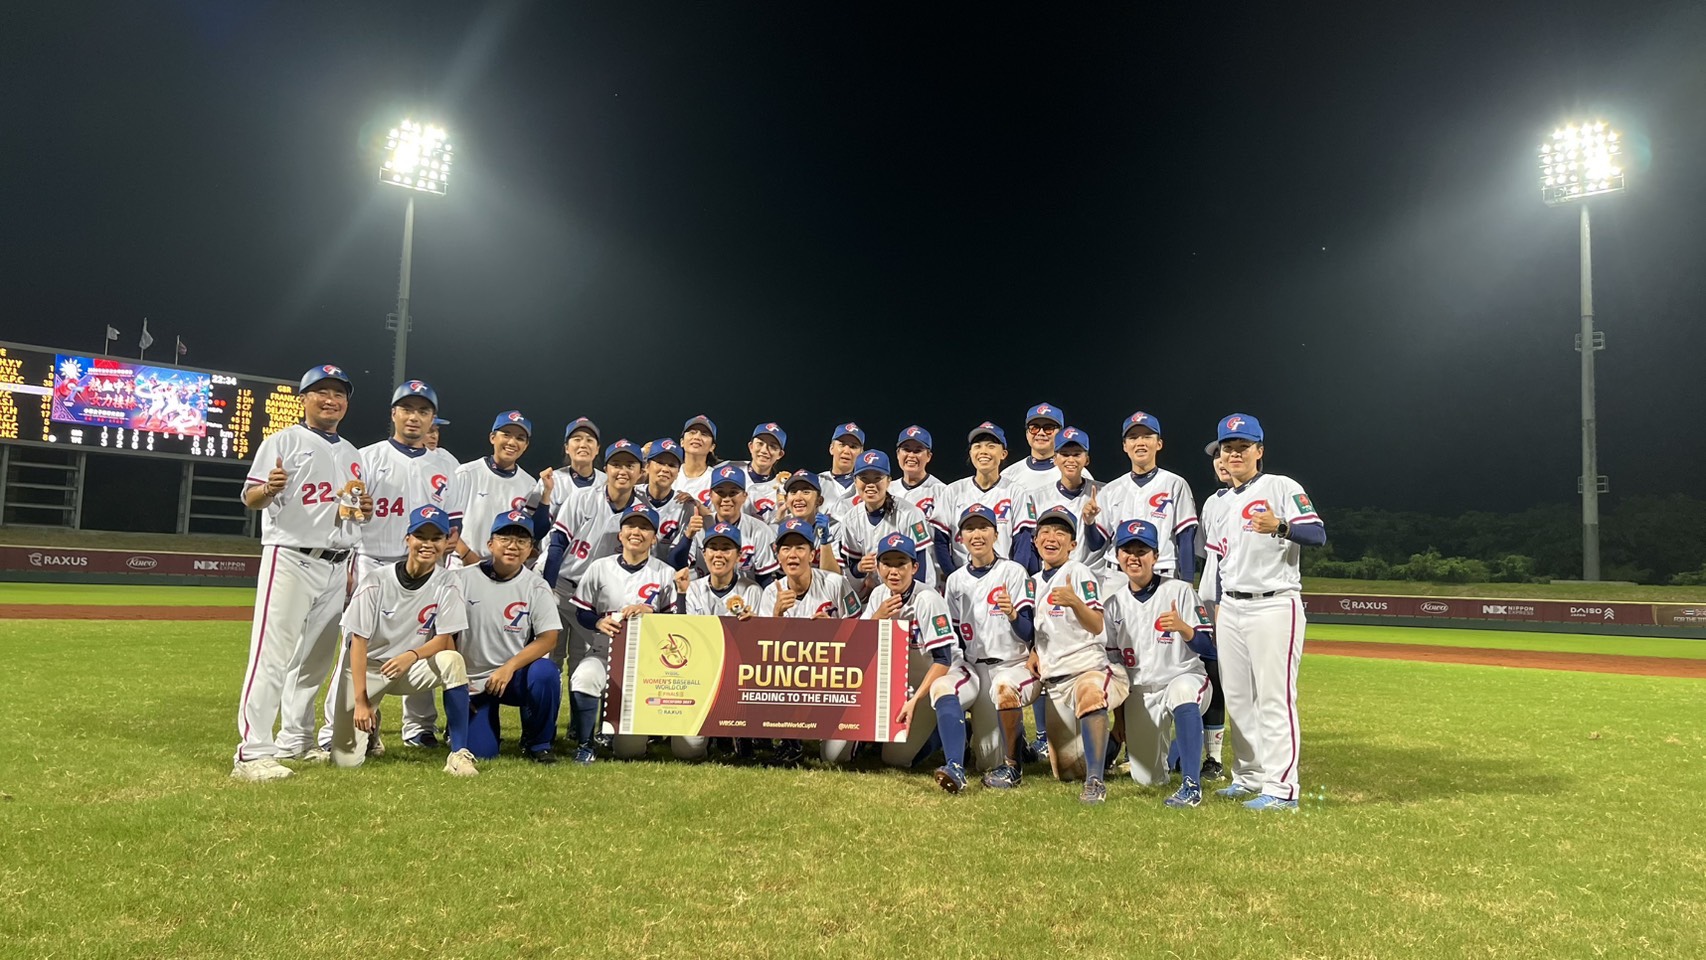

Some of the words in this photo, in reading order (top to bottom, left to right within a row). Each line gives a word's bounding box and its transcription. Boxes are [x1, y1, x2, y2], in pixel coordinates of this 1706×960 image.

[212, 375, 237, 385] 22:34
[302, 482, 333, 505] 22
[375, 497, 404, 518] 34
[569, 538, 591, 560] 16
[44, 556, 88, 566] RAXUS
[1352, 602, 1388, 610] RAXUS
[757, 640, 846, 663] TICKET
[737, 665, 864, 689] PUNCHED
[741, 692, 785, 702] HEADING
[786, 692, 798, 702] TO
[800, 693, 820, 703] THE
[822, 693, 857, 704] FINALS
